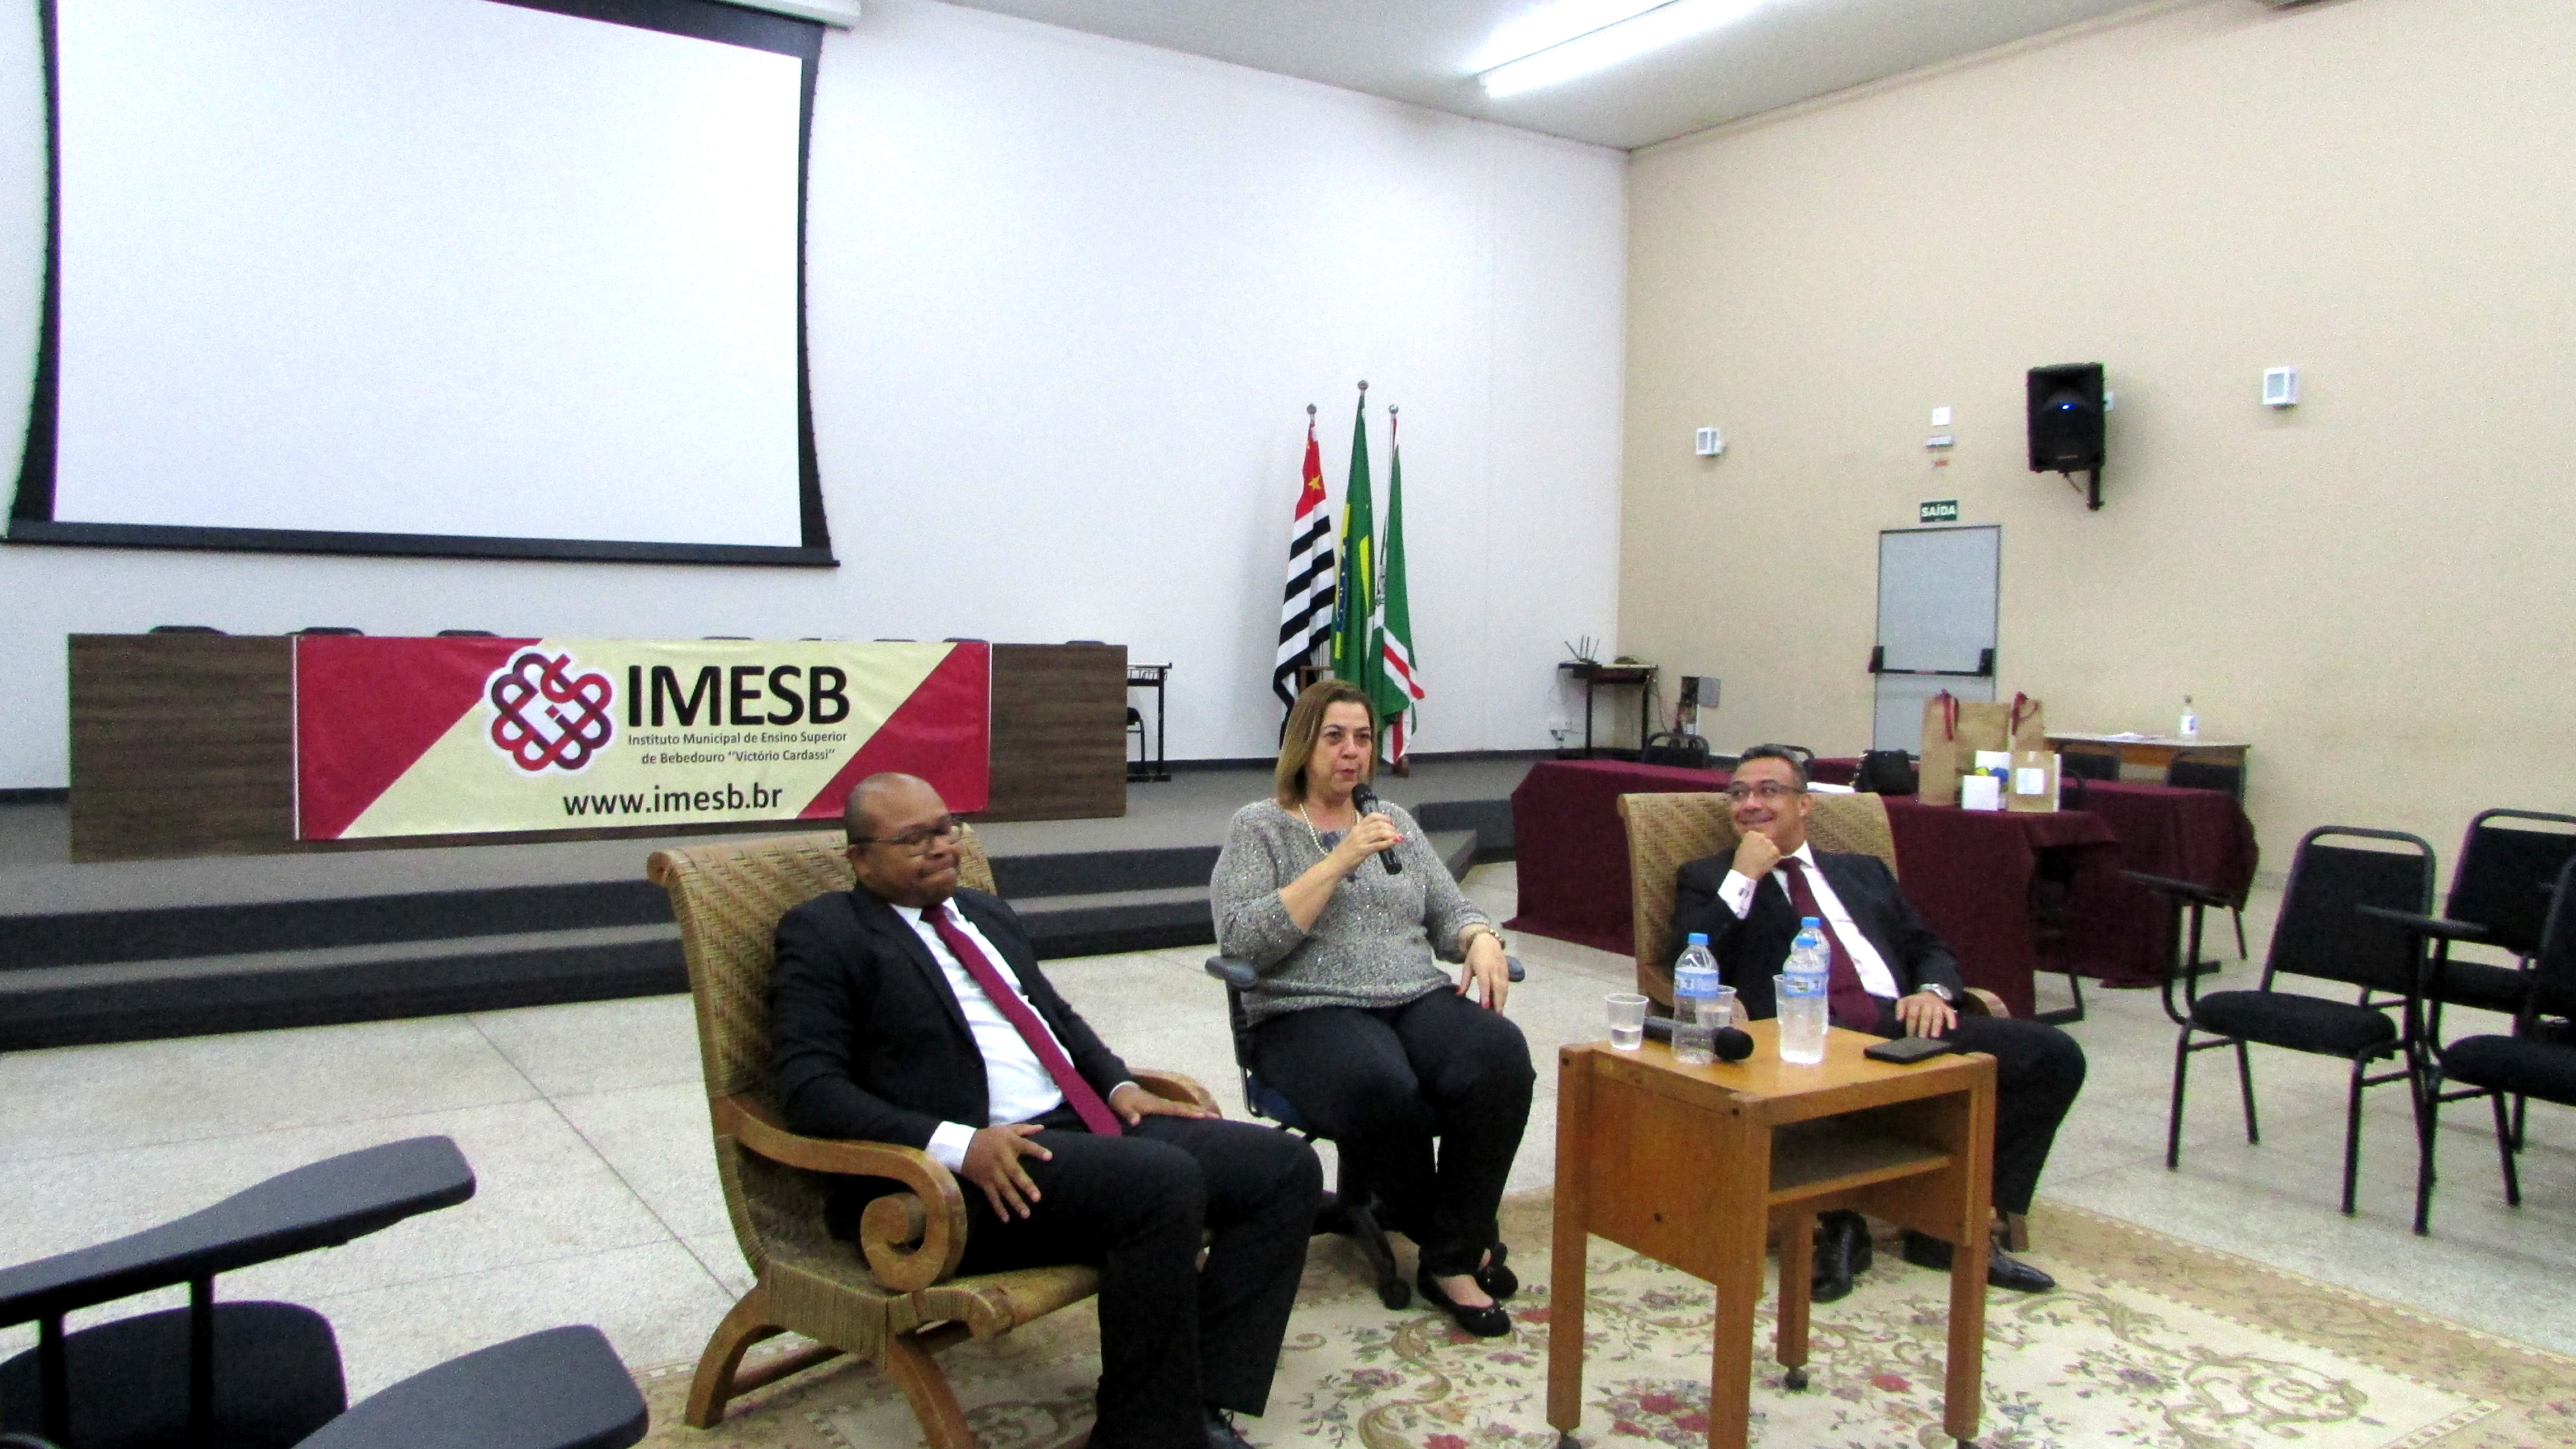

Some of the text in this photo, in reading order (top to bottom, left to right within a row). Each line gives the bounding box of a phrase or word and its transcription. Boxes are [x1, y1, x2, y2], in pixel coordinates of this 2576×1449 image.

[1921, 504, 1956, 517] SAÍDA
[628, 665, 850, 727] IMESB
[628, 731, 847, 745] Instituto Municipal de Ensino Superior
[642, 753, 656, 764] de
[660, 752, 726, 764] Bebedouro
[783, 749, 835, 761] Cardassi"
[562, 782, 783, 816] www.imesb.br
